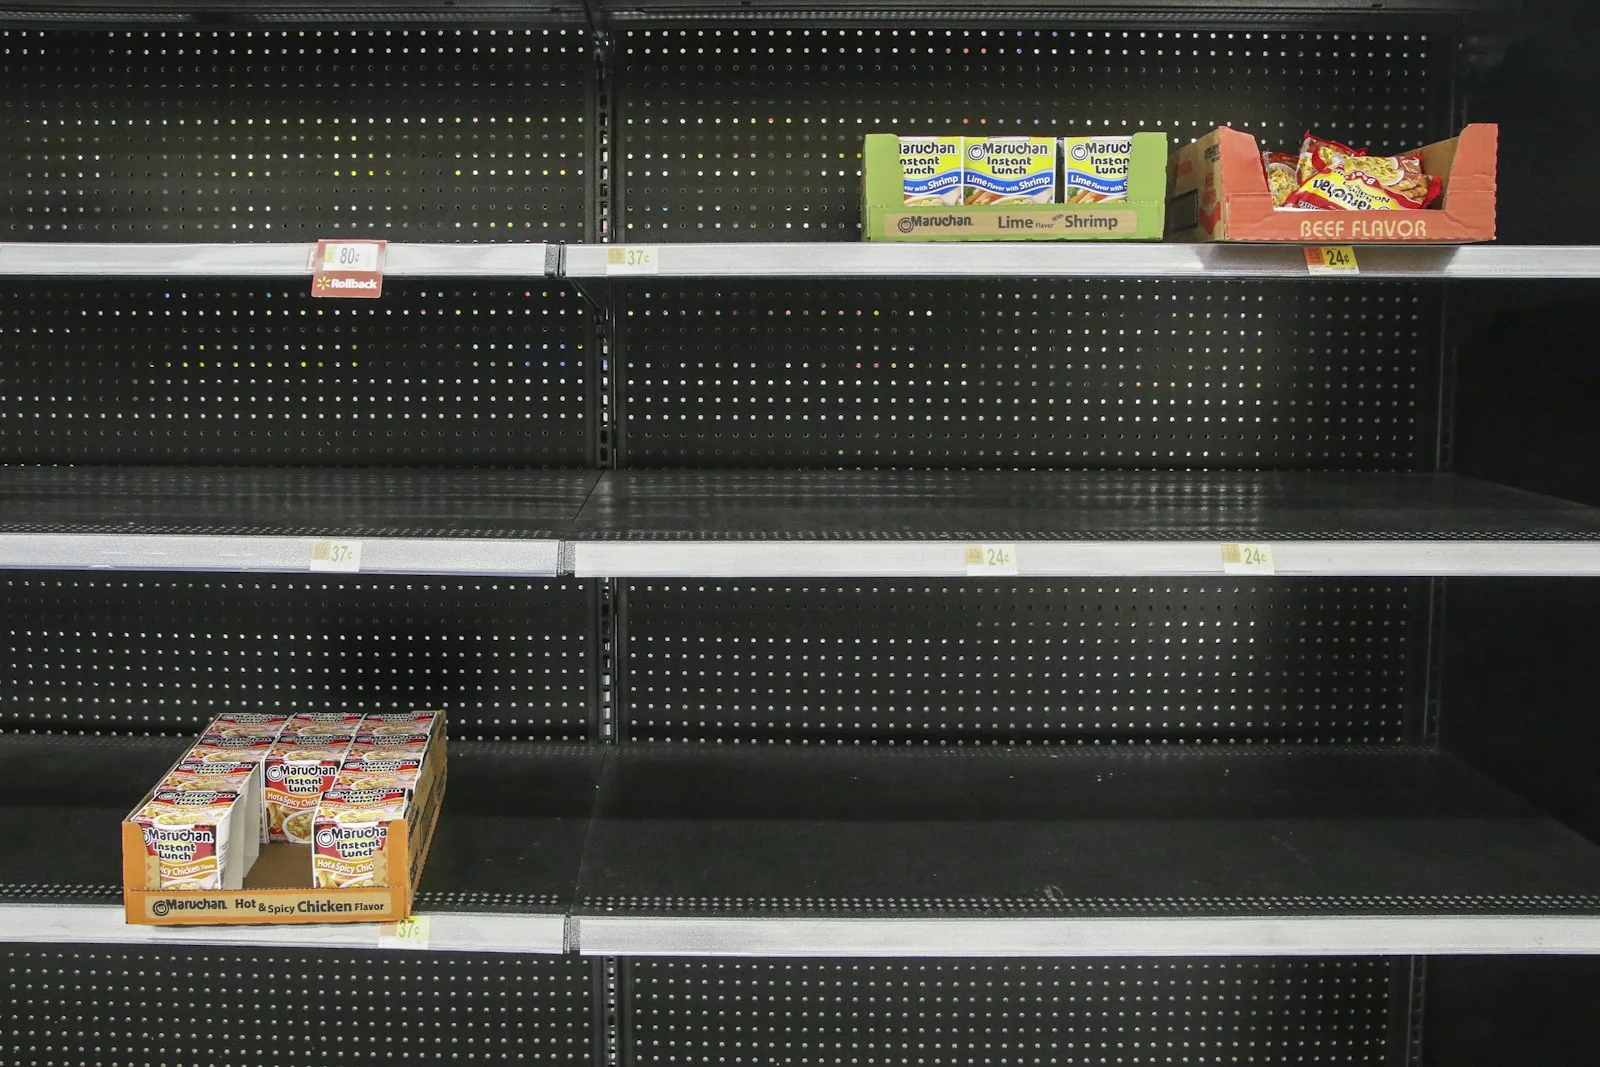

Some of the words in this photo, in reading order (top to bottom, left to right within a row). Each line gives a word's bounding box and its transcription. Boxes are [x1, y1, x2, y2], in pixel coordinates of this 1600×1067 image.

[899, 142, 955, 154] aruchan
[983, 142, 1048, 155] Maruchan
[900, 156, 940, 166] nstant
[987, 156, 1031, 166] Instant
[1091, 156, 1130, 166] Instan
[903, 166, 935, 175] unch
[992, 166, 1027, 175] Lunch
[928, 175, 959, 189] Shrimp
[967, 174, 987, 187] Lime
[987, 182, 1005, 192] Flavor
[1006, 184, 1019, 192] with
[1019, 175, 1051, 189] Shrimp
[1071, 174, 1092, 187] Lime
[1092, 181, 1109, 191] Flavor
[1110, 183, 1124, 192] with
[911, 214, 972, 228] Maruchan
[998, 216, 1034, 229] Lime
[1065, 215, 1118, 231] Shrimp
[1300, 220, 1345, 237] BEEF
[1352, 220, 1426, 237] FLAVOR
[1326, 249, 1350, 266] 24¢
[331, 277, 378, 289] Rollback
[280, 764, 336, 776] Maruchan
[284, 777, 322, 786] Instant
[289, 785, 319, 793] Lunch
[149, 829, 211, 842] Maruchan
[332, 827, 387, 840] Marucha
[154, 841, 196, 852] Instant
[337, 840, 381, 851] Instant
[159, 852, 191, 861] Lunch
[173, 865, 200, 876] Chicken
[166, 899, 227, 910] Maruchan
[235, 899, 256, 909] Hot
[258, 903, 267, 912] &
[268, 904, 295, 915] Spicy
[297, 900, 352, 913] Chicken
[354, 902, 384, 911] Flavor
